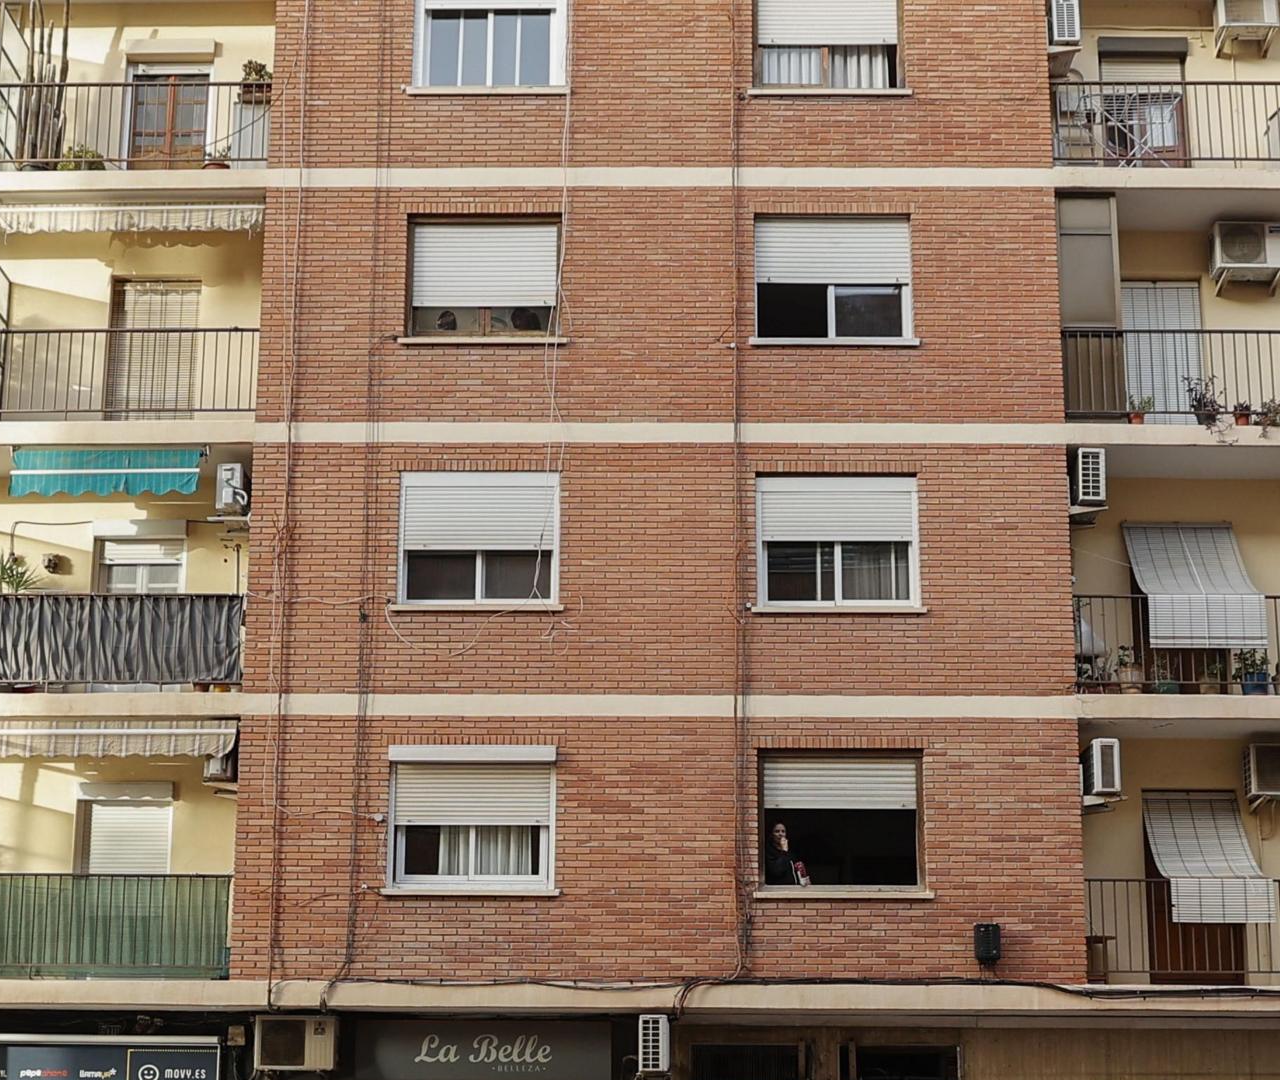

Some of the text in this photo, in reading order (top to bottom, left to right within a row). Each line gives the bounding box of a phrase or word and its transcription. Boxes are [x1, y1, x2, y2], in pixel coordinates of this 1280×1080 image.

[414, 1033, 553, 1063] La Belle
[164, 1069, 206, 1079] MOVY.ES
